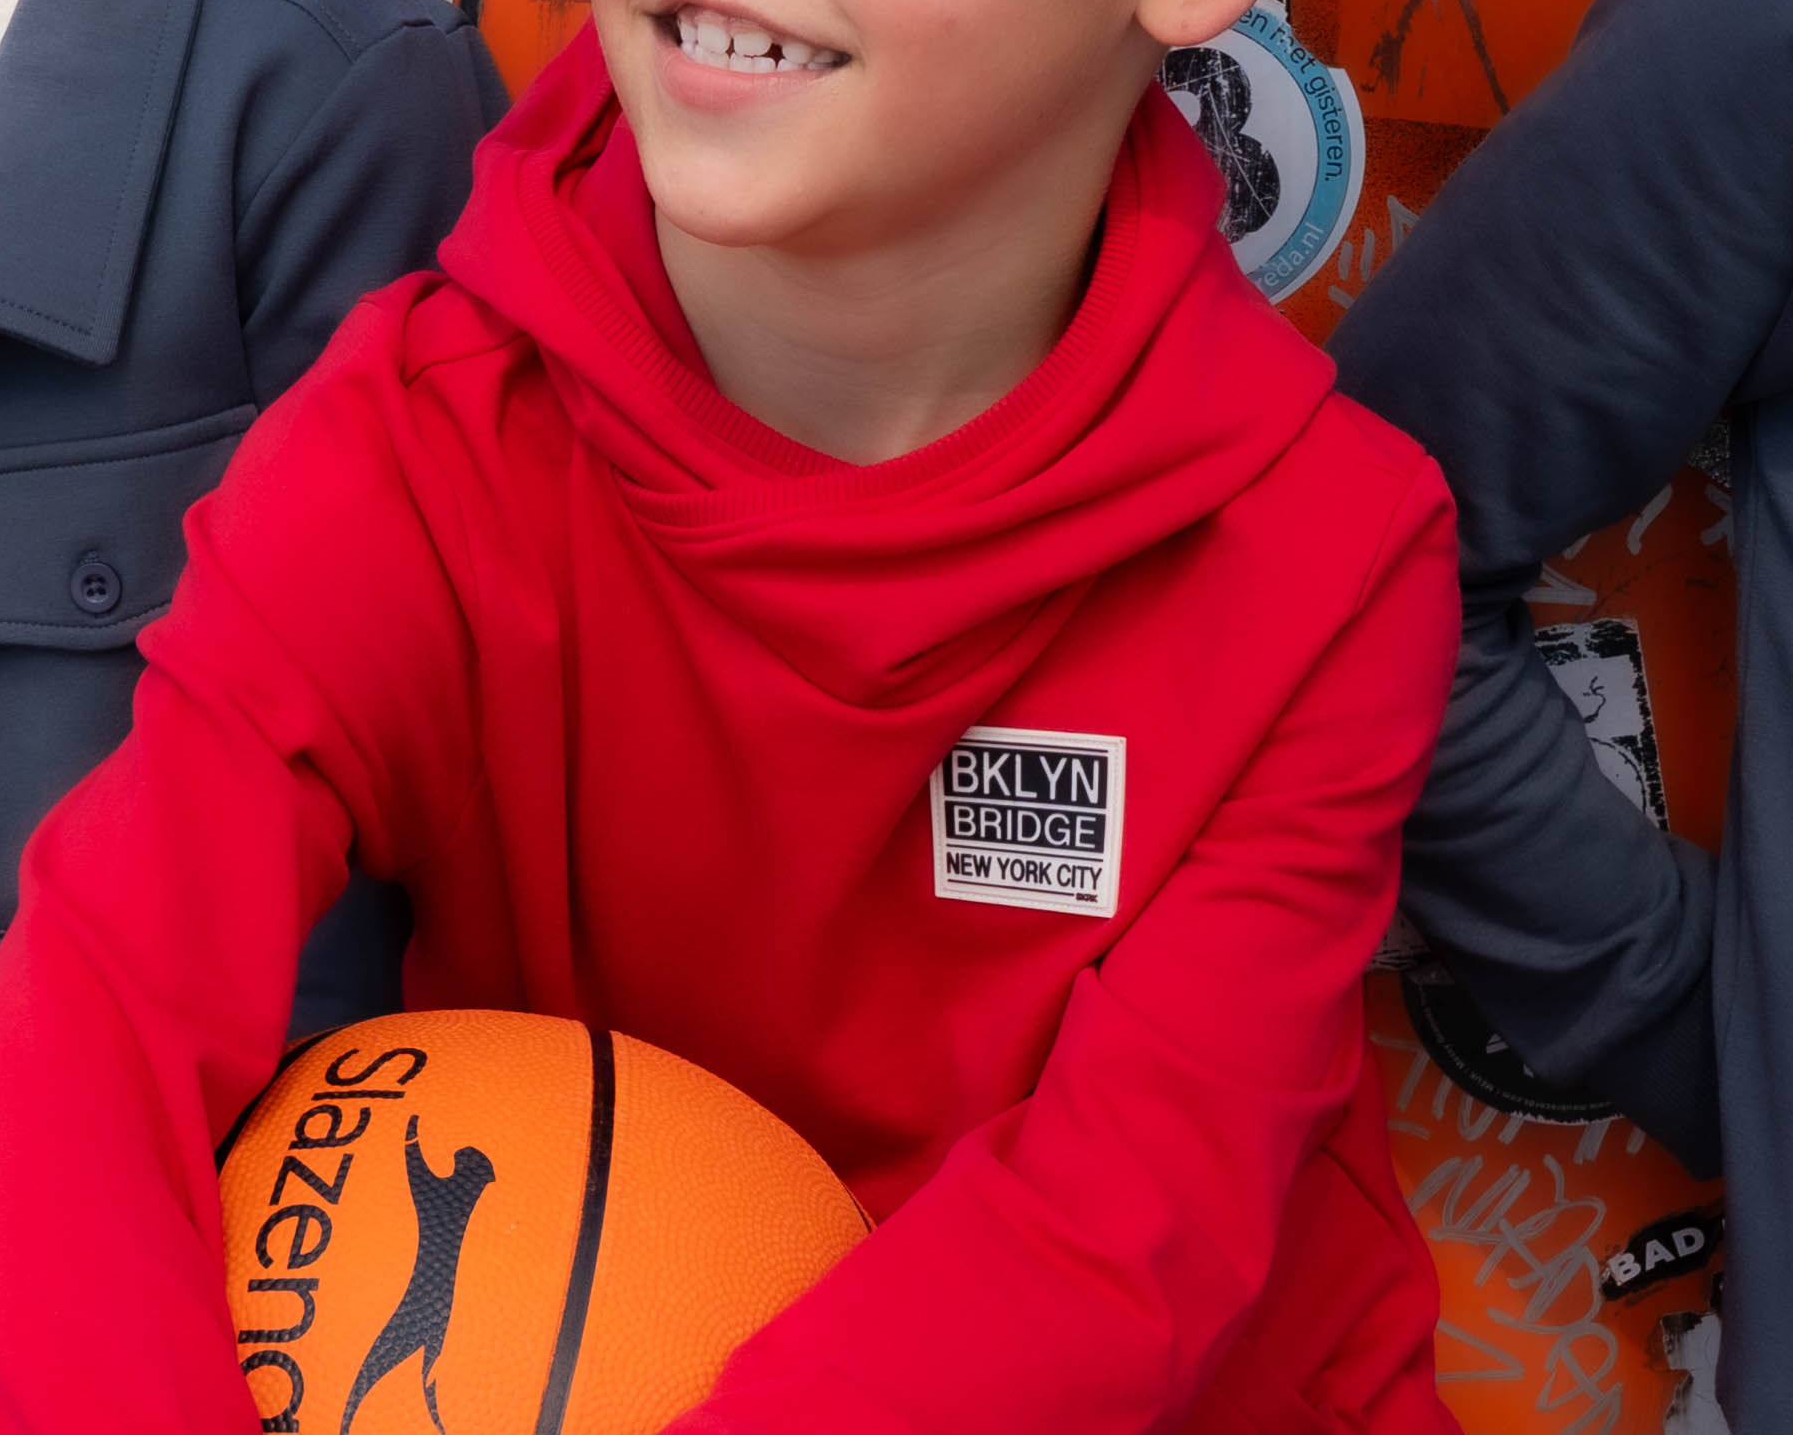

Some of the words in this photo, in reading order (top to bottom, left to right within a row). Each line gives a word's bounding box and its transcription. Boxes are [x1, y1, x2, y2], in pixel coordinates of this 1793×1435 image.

[1304, 76, 1343, 182] gisteren.
[951, 750, 1100, 804] BKLYN
[953, 805, 1096, 849] BRIDGE
[946, 852, 992, 878] NEW
[997, 857, 1052, 885] YORK
[1057, 864, 1102, 890] CITY
[1607, 1226, 1706, 1286] BAD
